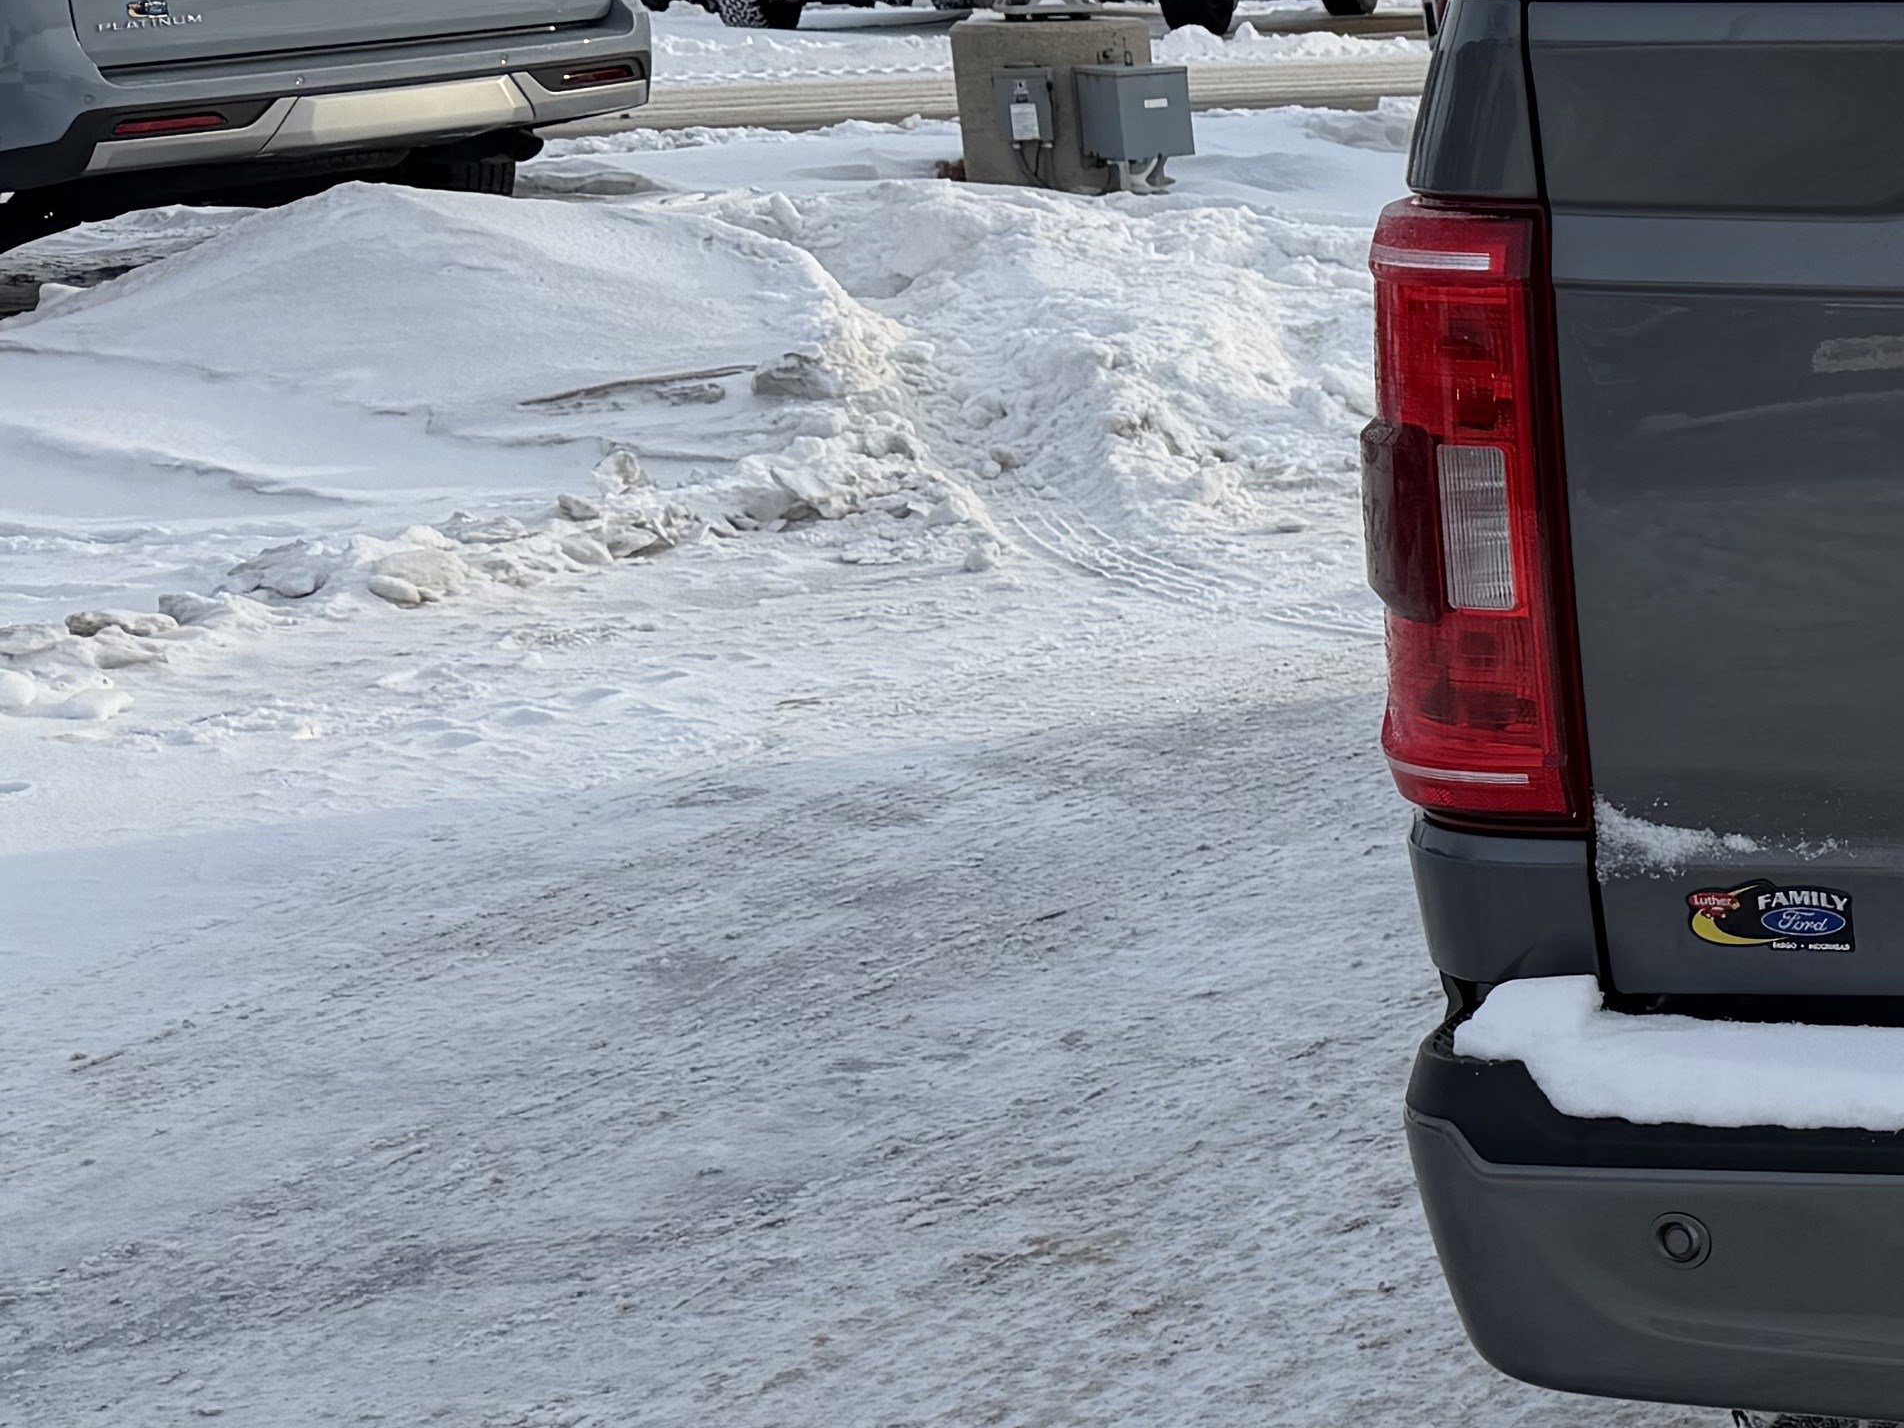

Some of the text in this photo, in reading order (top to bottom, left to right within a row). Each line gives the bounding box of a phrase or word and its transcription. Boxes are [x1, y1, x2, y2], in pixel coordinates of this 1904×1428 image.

[97, 14, 202, 32] PLATINUM
[1693, 894, 1732, 906] Luther
[1757, 890, 1848, 912] FAMILY
[1777, 909, 1828, 931] Ford
